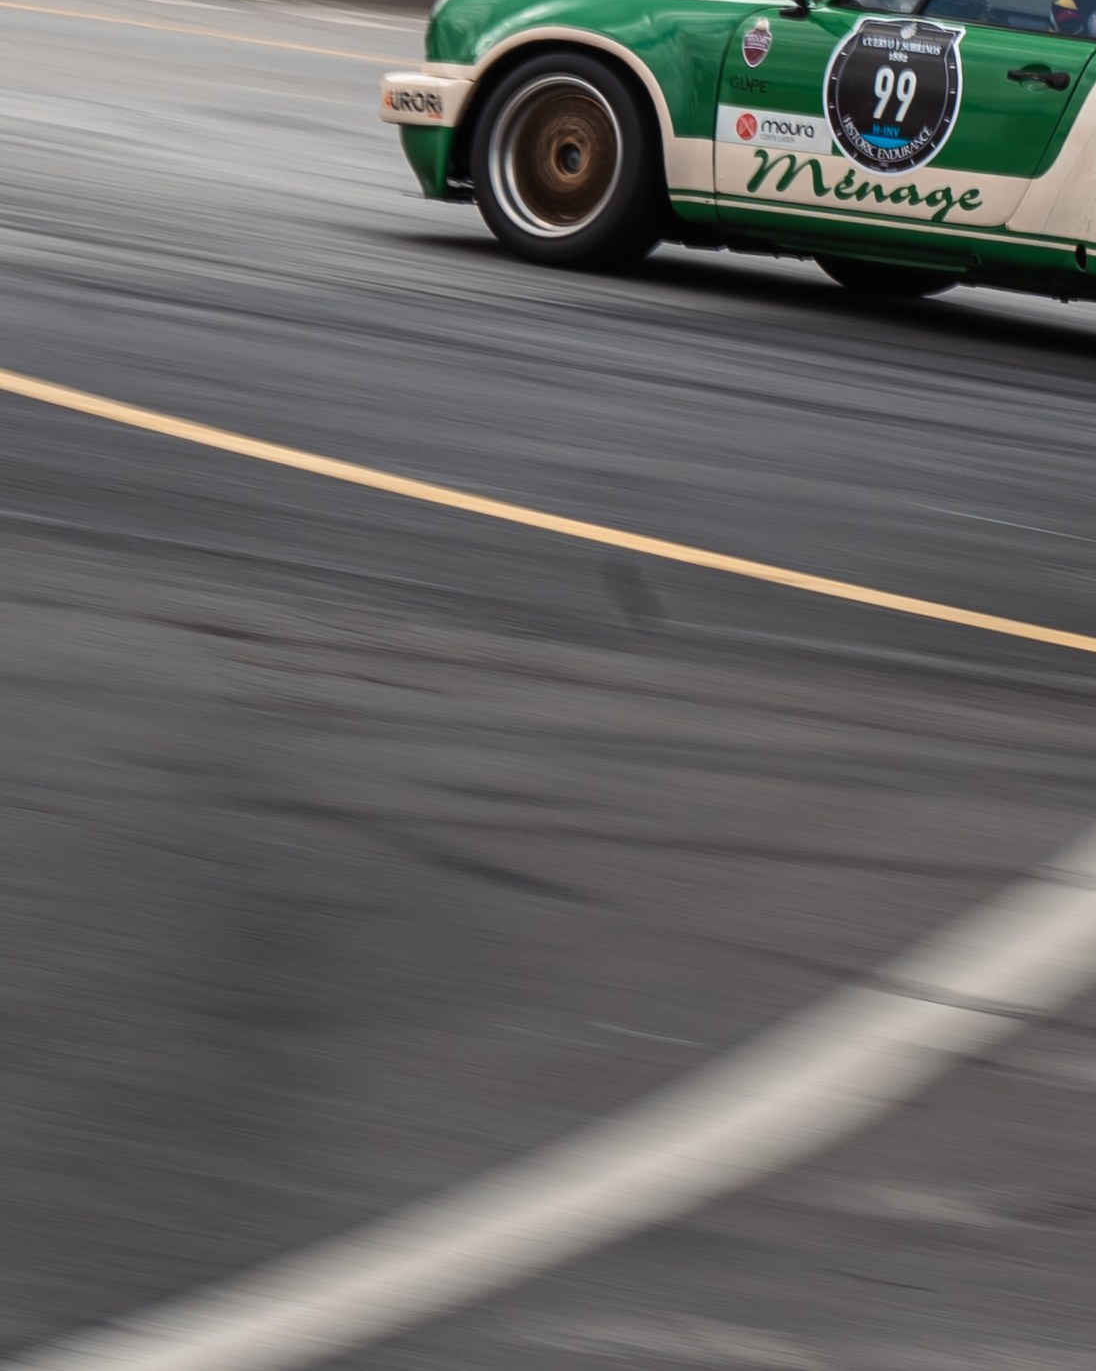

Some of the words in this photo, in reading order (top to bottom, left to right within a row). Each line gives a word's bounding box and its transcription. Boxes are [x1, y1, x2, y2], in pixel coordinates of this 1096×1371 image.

[873, 65, 917, 122] 99
[761, 119, 815, 139] moura
[842, 115, 877, 158] HISTORIC
[877, 126, 933, 161] ENDURANCE
[746, 149, 983, 223] Ménage
